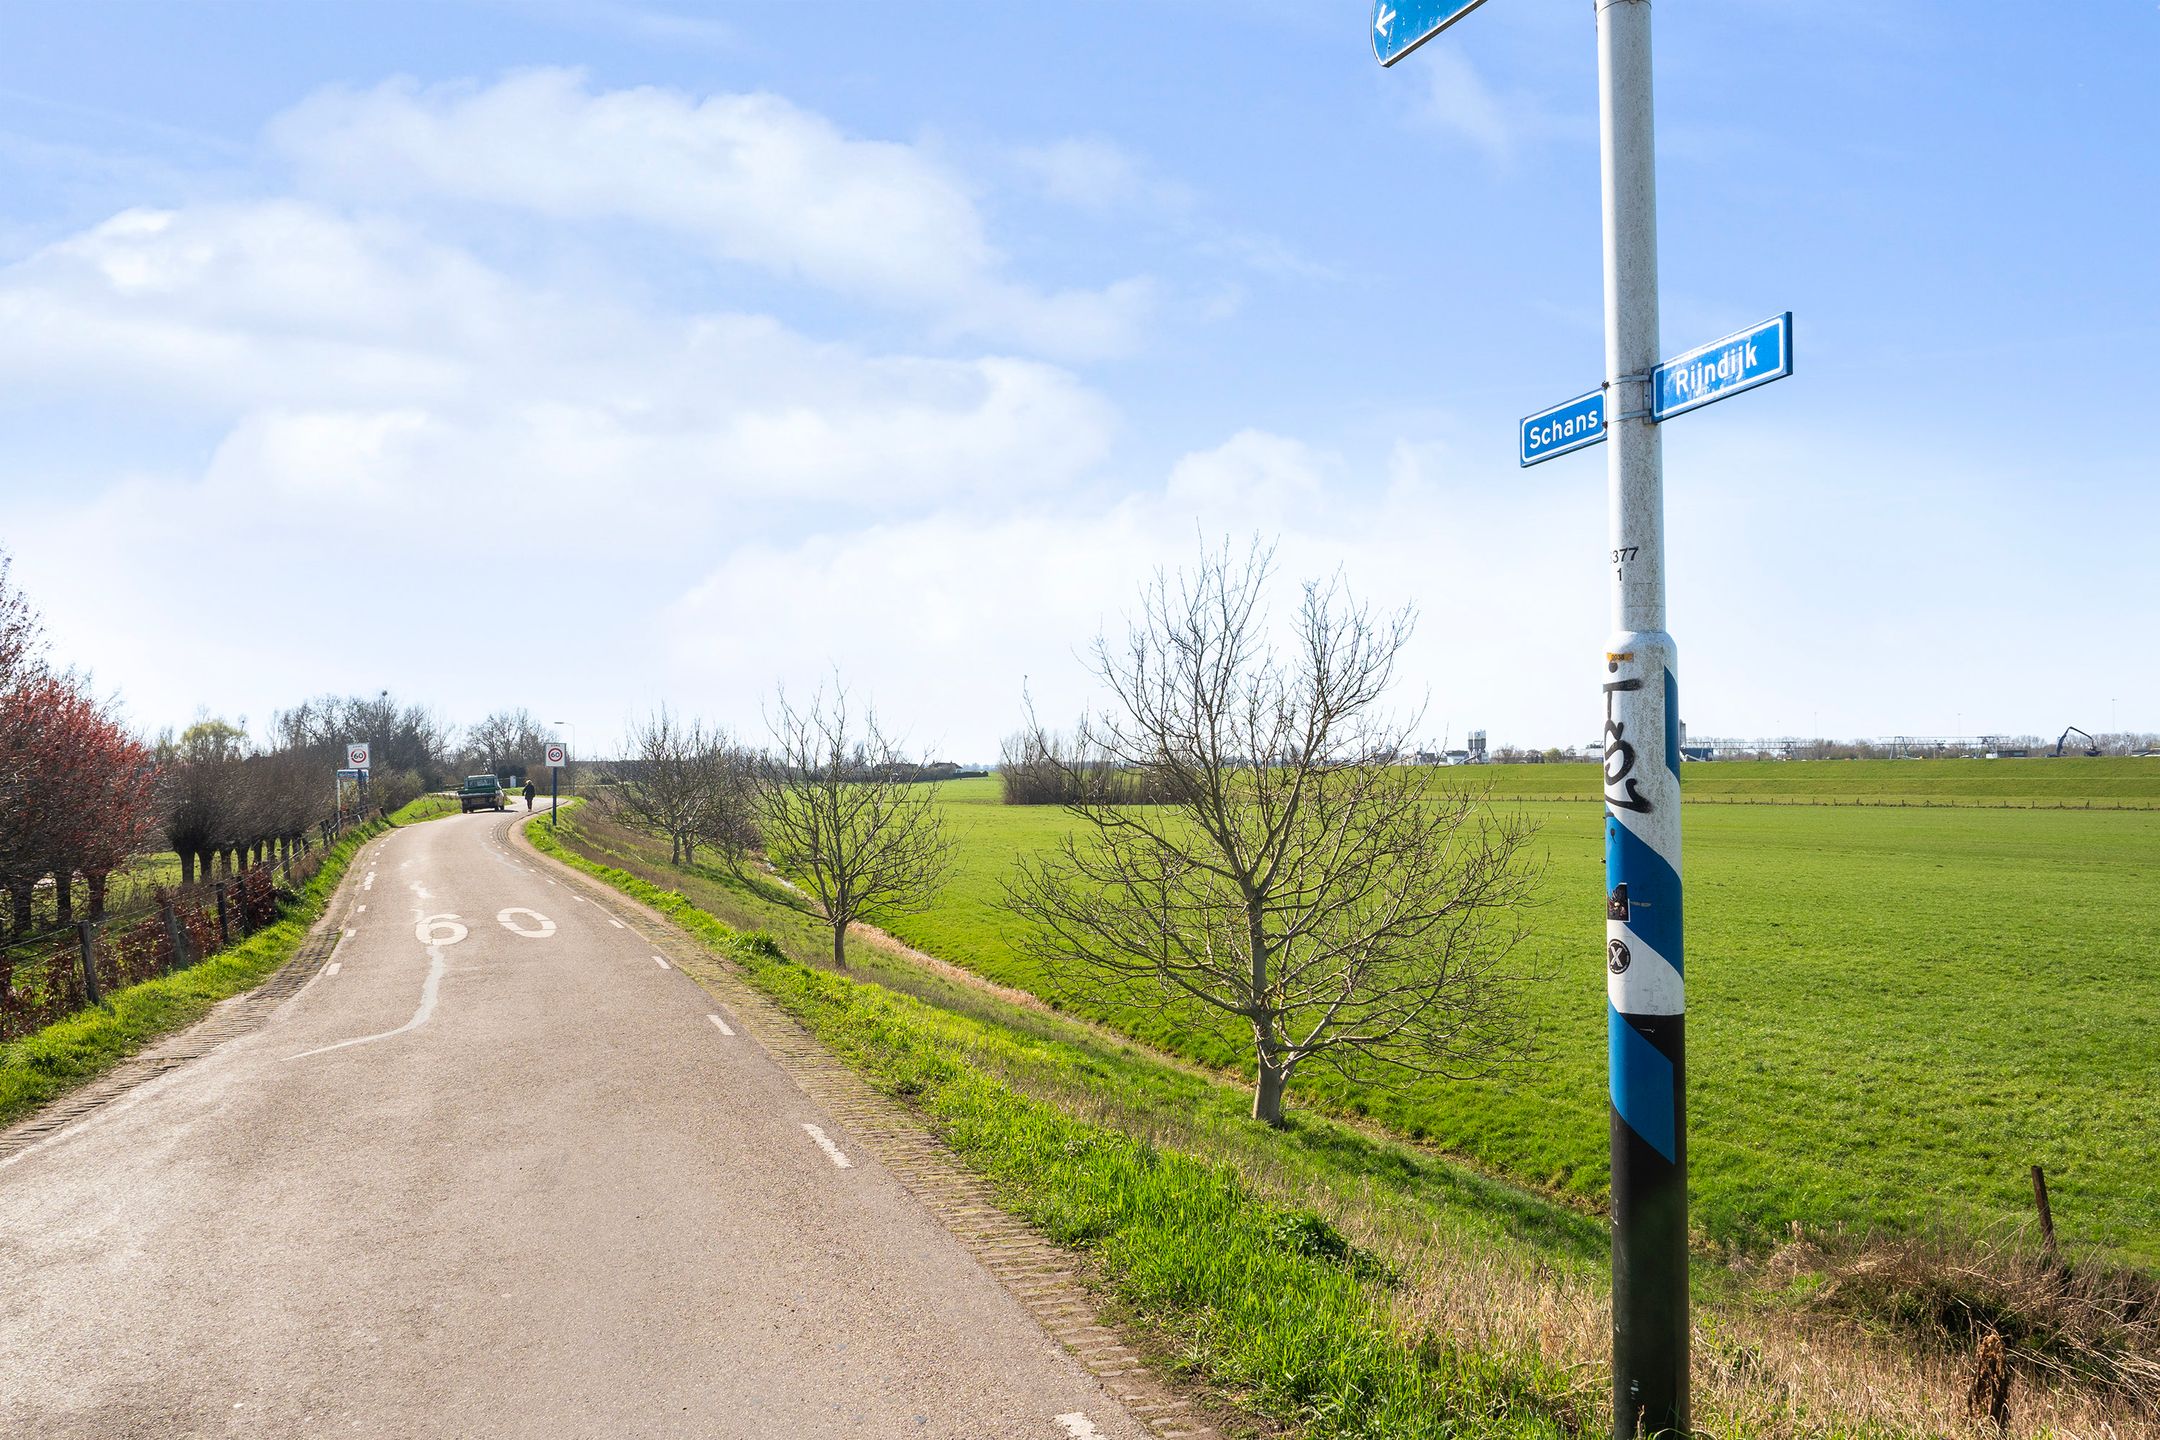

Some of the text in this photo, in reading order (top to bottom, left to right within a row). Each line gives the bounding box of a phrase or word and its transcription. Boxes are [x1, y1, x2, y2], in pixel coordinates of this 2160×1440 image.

[1675, 342, 1758, 396] Rijndijk
[1529, 409, 1598, 449] Schans
[1616, 568, 1622, 581] 1
[415, 907, 557, 945] 60
